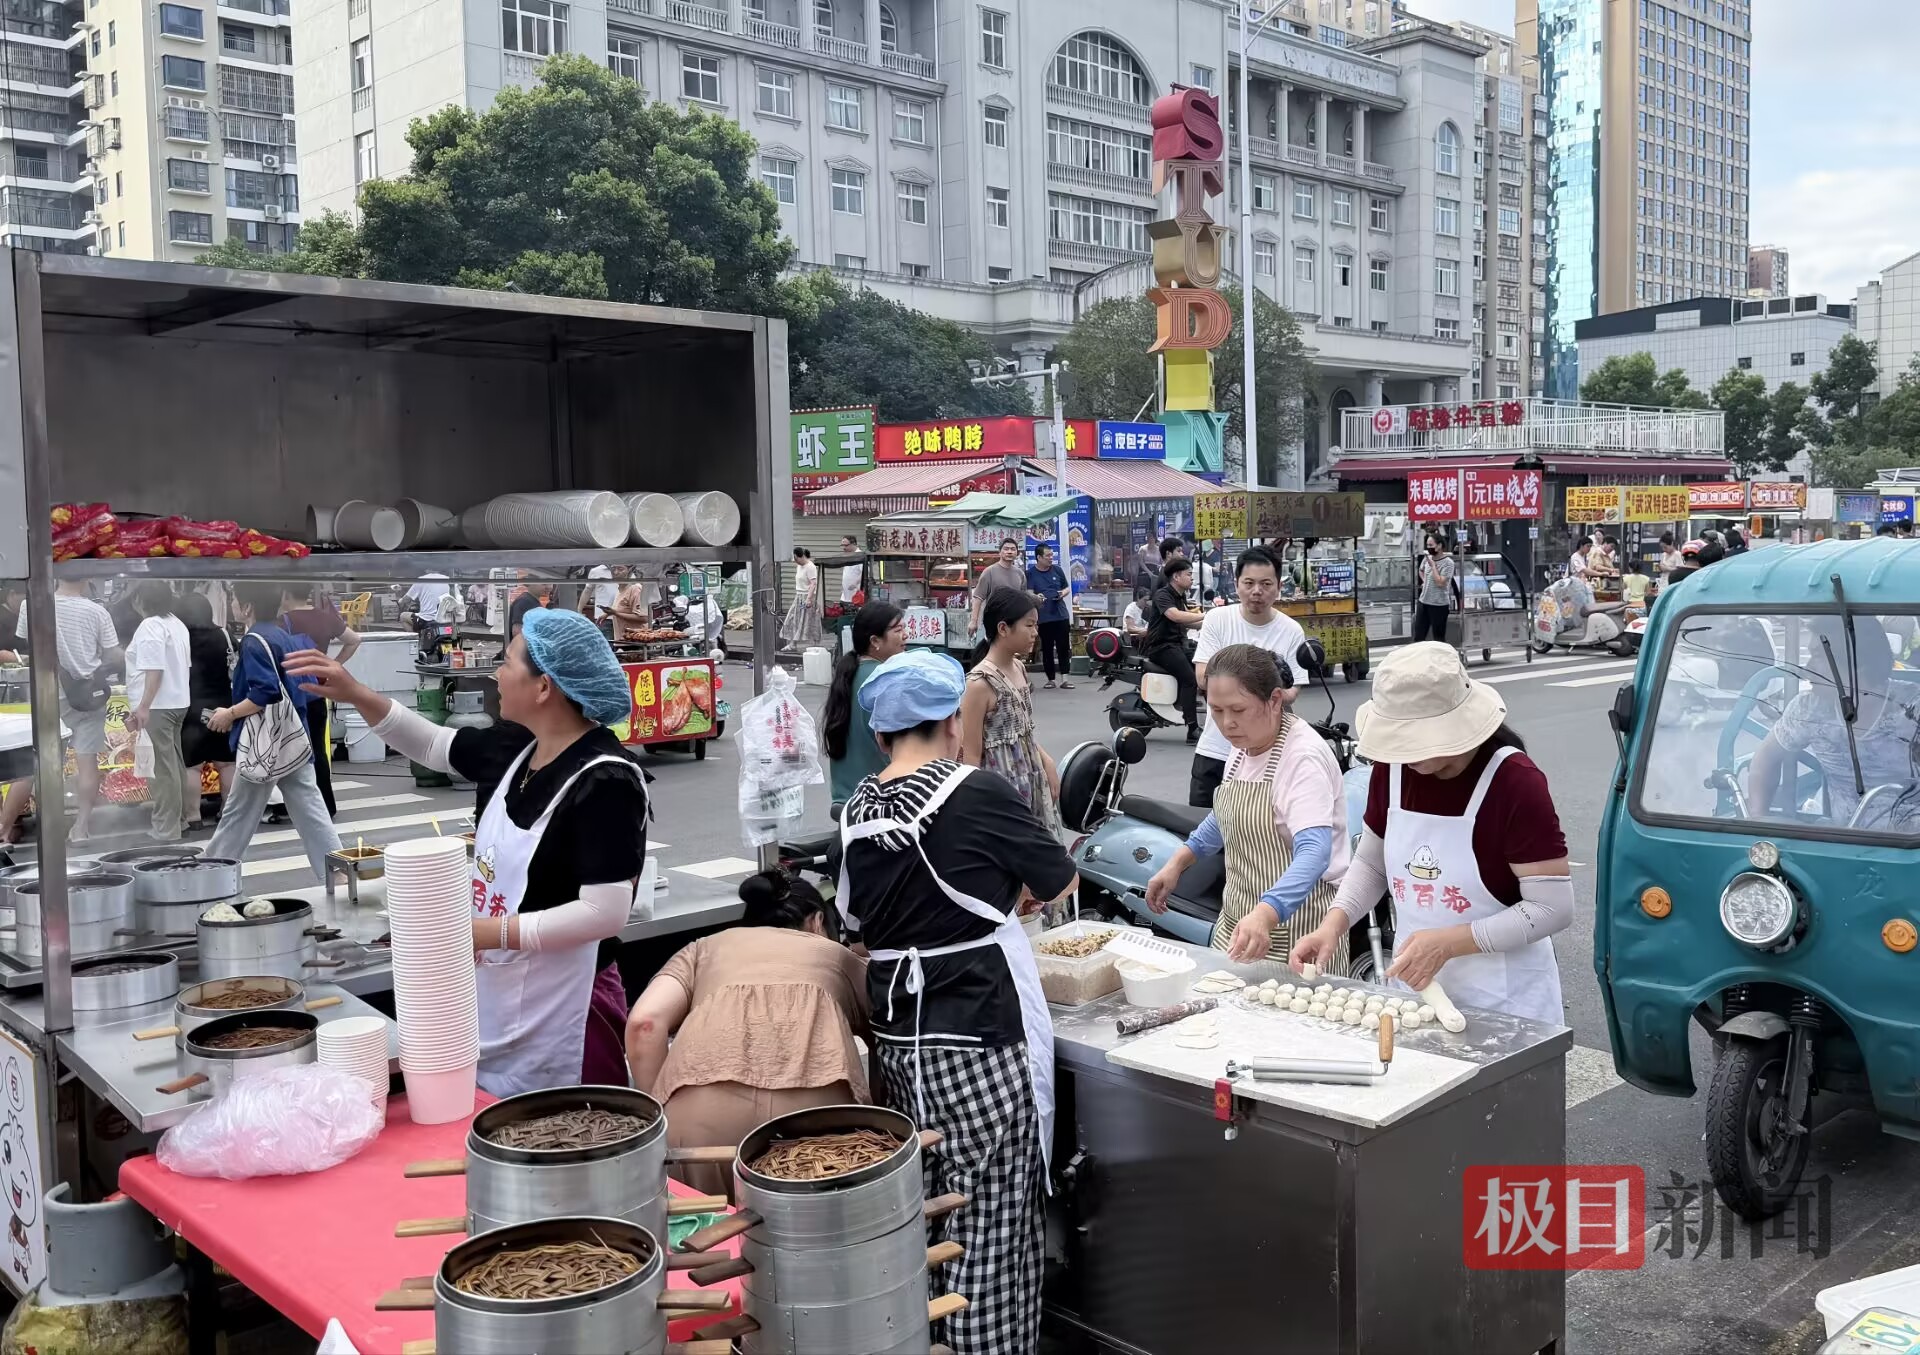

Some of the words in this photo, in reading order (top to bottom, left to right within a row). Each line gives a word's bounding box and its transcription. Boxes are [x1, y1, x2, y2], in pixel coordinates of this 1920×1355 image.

[797, 424, 868, 469] 虾王
[904, 424, 983, 456] 绝味鸭脖
[1115, 432, 1148, 449] 夜包子
[1410, 477, 1458, 502] 朱哥烧烤
[1467, 472, 1539, 506] 1元1串烧烤
[1635, 493, 1686, 515] 武汉特色豆皮
[888, 527, 961, 554] 老北京爆肚
[640, 673, 653, 703] 陈记
